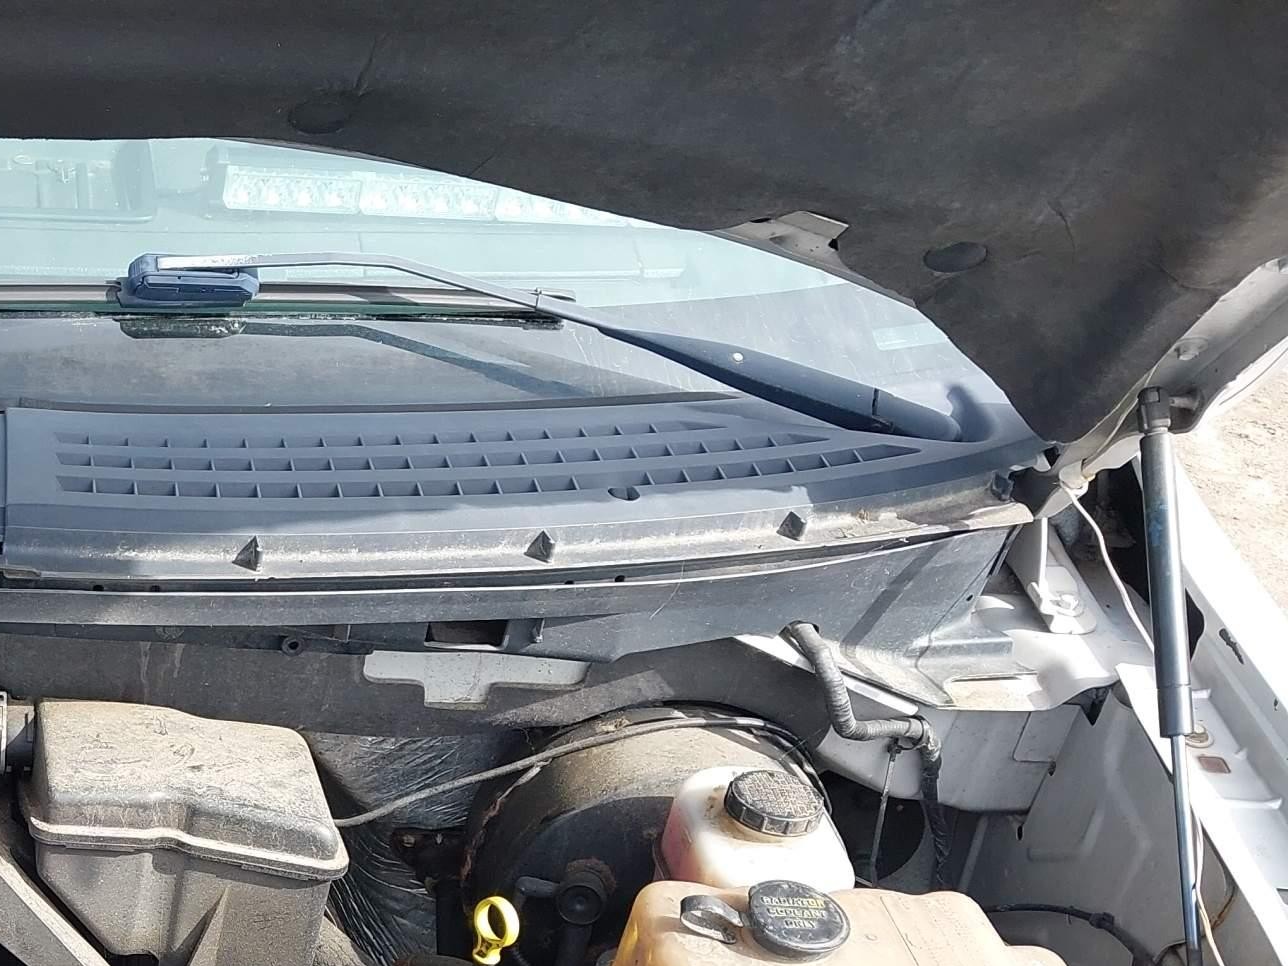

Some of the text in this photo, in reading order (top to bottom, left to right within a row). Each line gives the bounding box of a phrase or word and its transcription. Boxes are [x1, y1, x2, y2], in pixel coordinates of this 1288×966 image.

[760, 895, 826, 909] RADIATOR
[767, 906, 826, 919] COOLANT
[784, 918, 817, 929] ONLY
